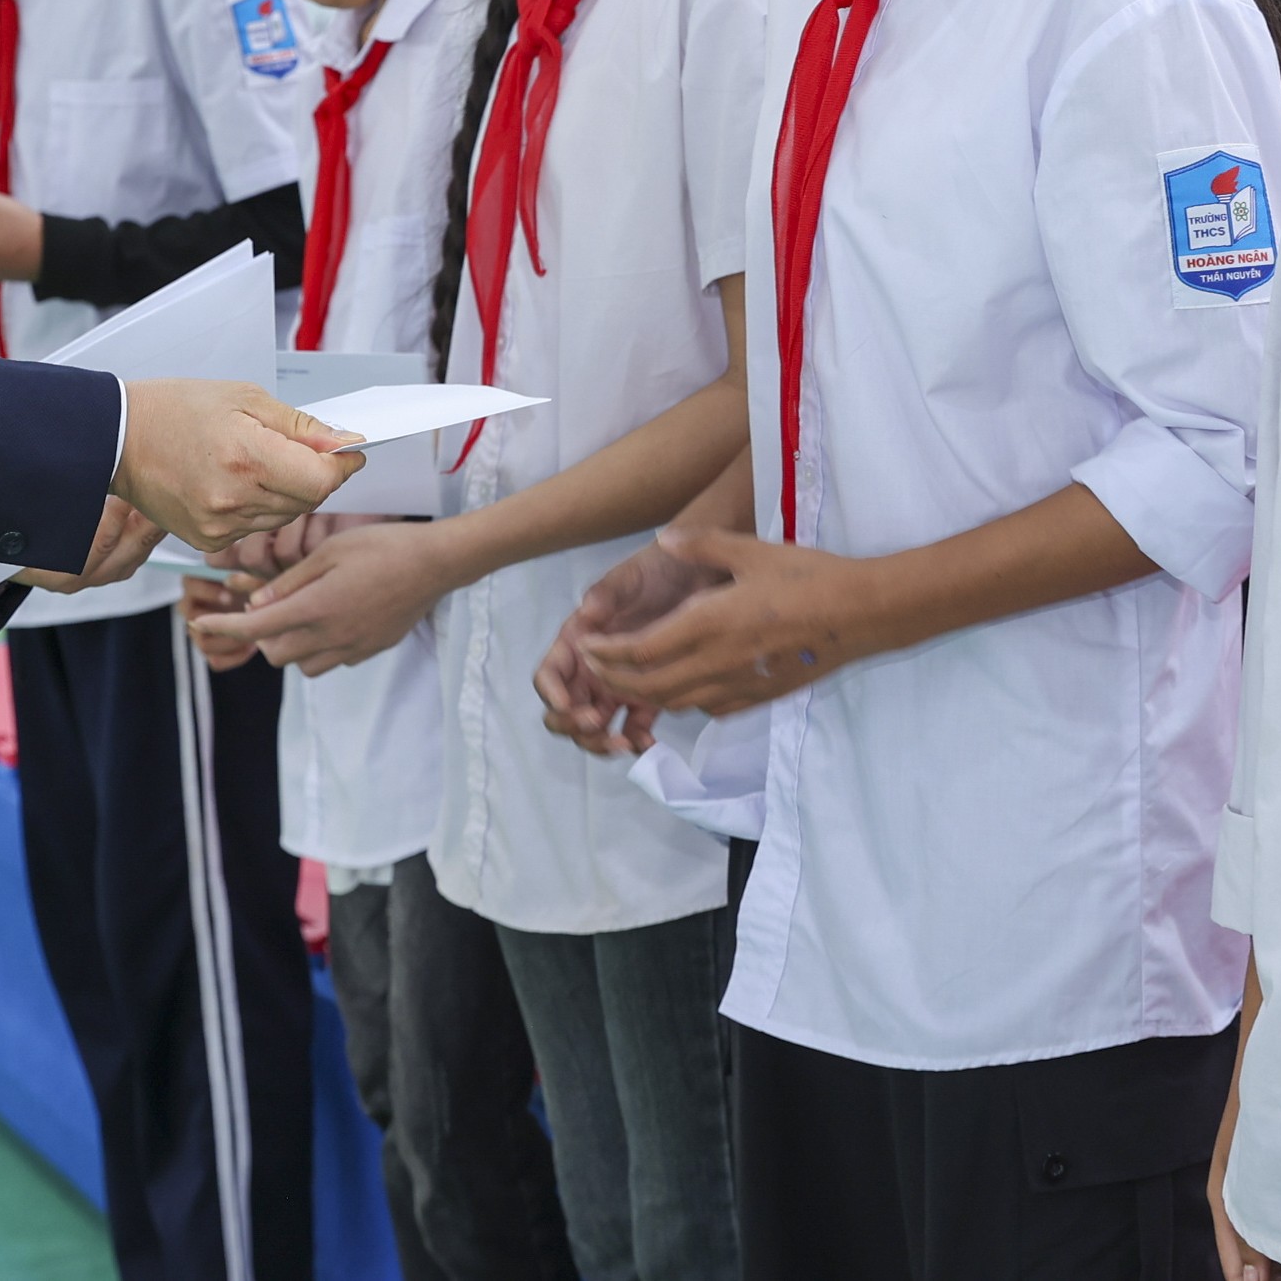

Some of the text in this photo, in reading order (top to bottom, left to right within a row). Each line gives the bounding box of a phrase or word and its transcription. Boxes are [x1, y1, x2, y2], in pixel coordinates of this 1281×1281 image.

[1188, 212, 1227, 225] TRƯỜNG
[1193, 227, 1226, 238] THCS
[1186, 250, 1268, 268] HOÀNG NGÂN
[1200, 268, 1261, 283] THÁI NGUYÊN
